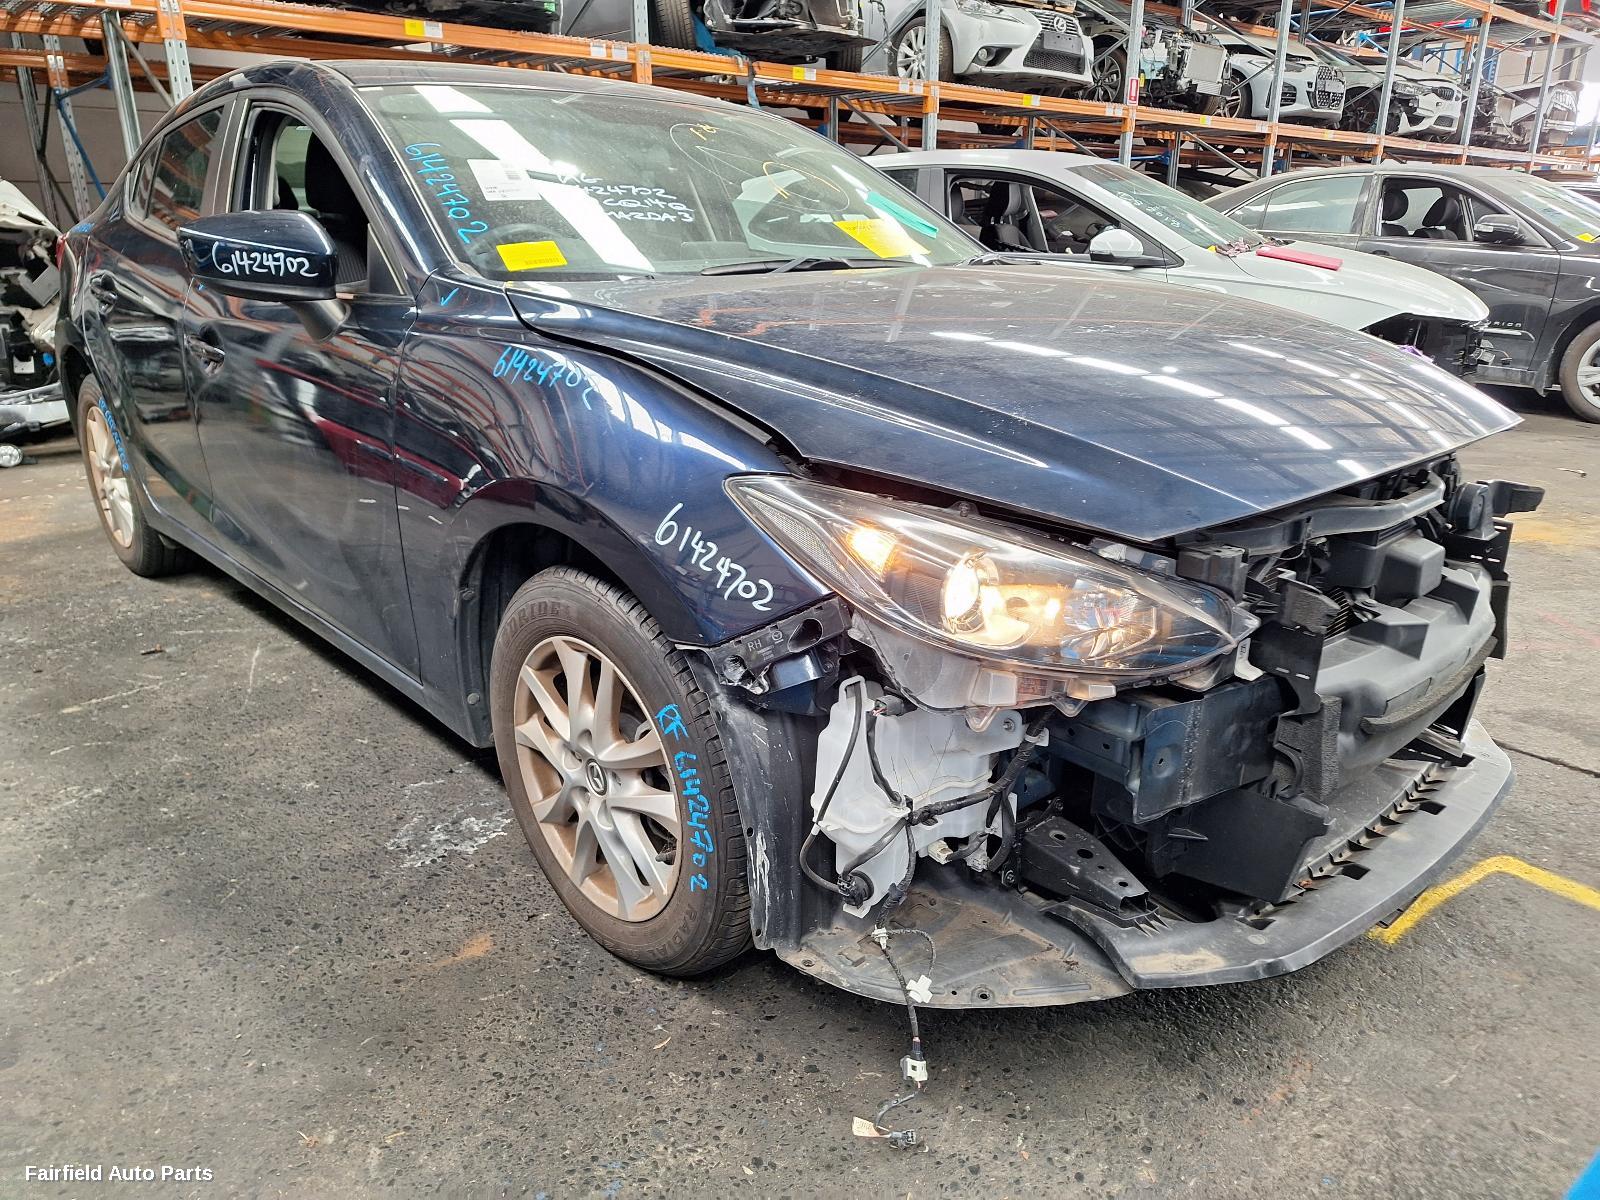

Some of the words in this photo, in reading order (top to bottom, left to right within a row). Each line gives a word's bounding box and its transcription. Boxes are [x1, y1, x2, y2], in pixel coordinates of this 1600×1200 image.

[404, 142, 488, 244] 61424702
[677, 211, 694, 222] 3
[211, 240, 319, 278] 61424702
[654, 502, 774, 612] 61424702
[747, 638, 763, 652] RH
